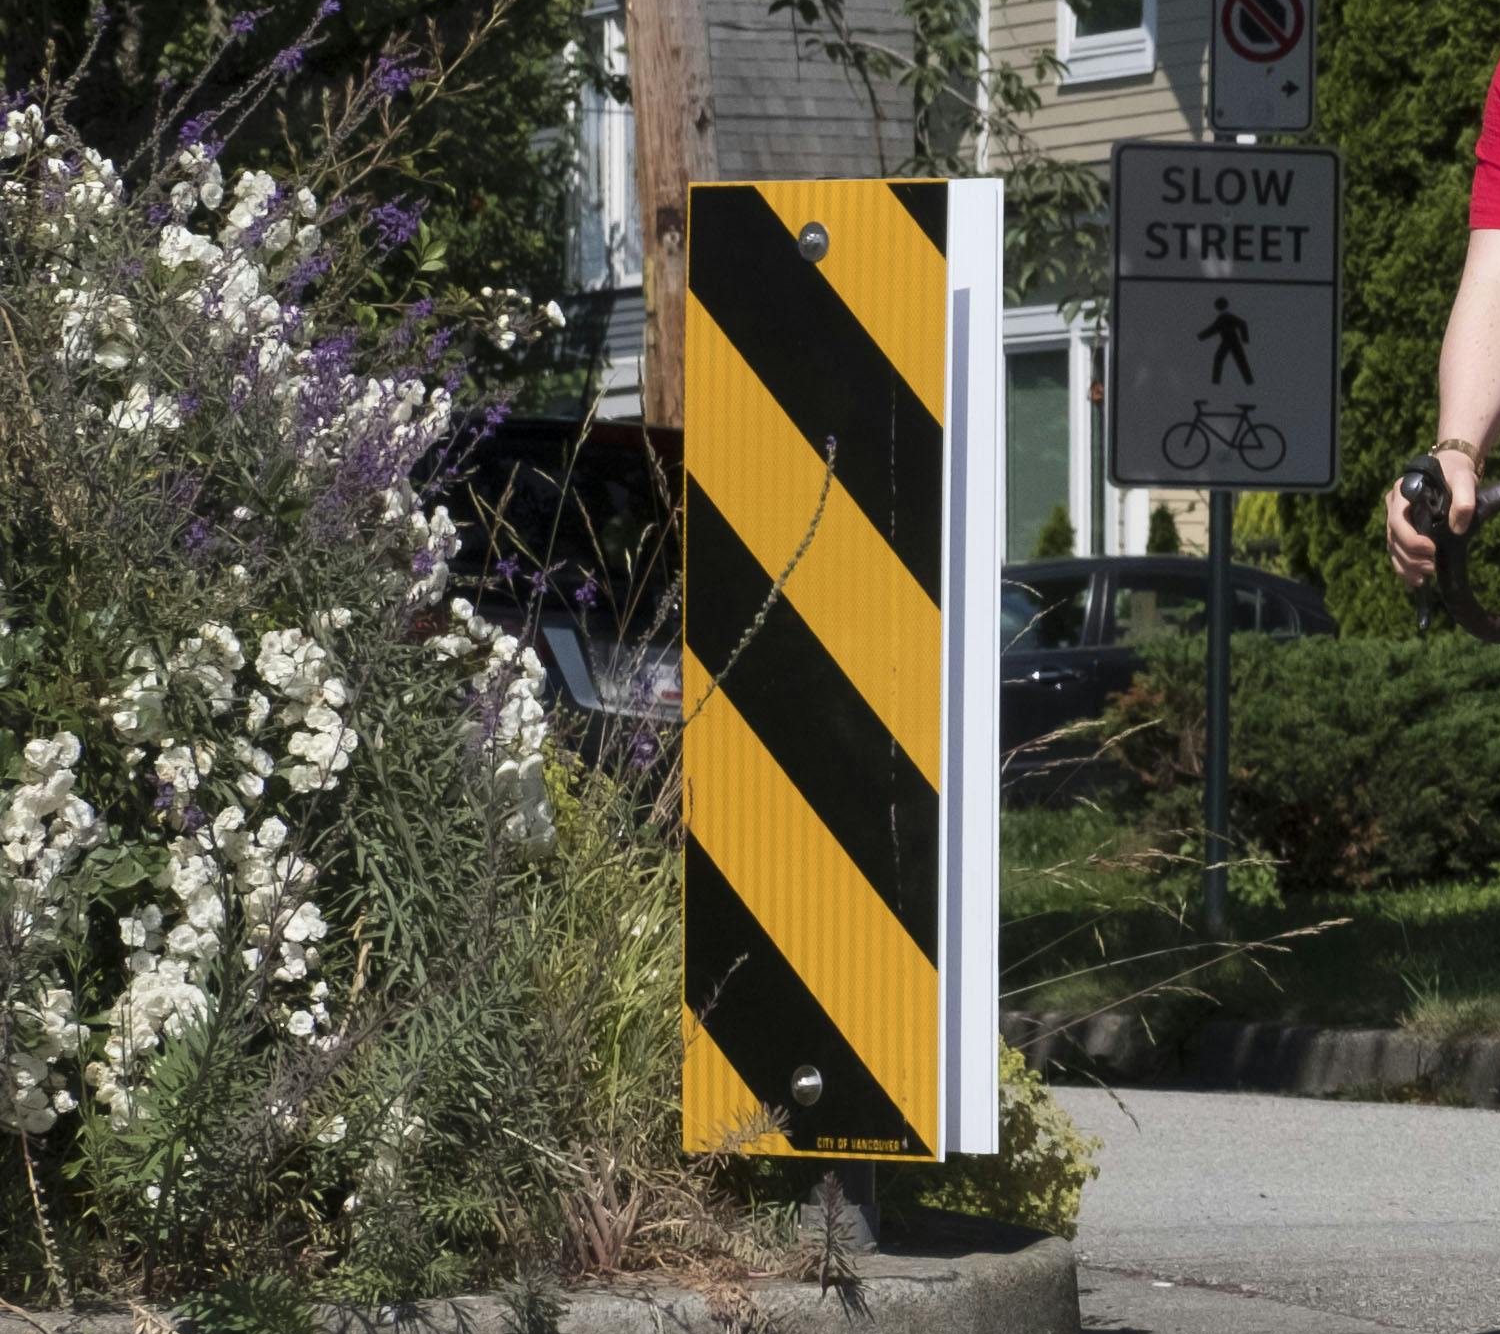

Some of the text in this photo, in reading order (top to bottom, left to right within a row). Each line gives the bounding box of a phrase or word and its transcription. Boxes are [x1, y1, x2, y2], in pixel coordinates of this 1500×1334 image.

[1161, 166, 1295, 206] SLOW
[1145, 221, 1310, 263] STREET
[816, 1137, 899, 1152] CITY OF VANCOUVER
